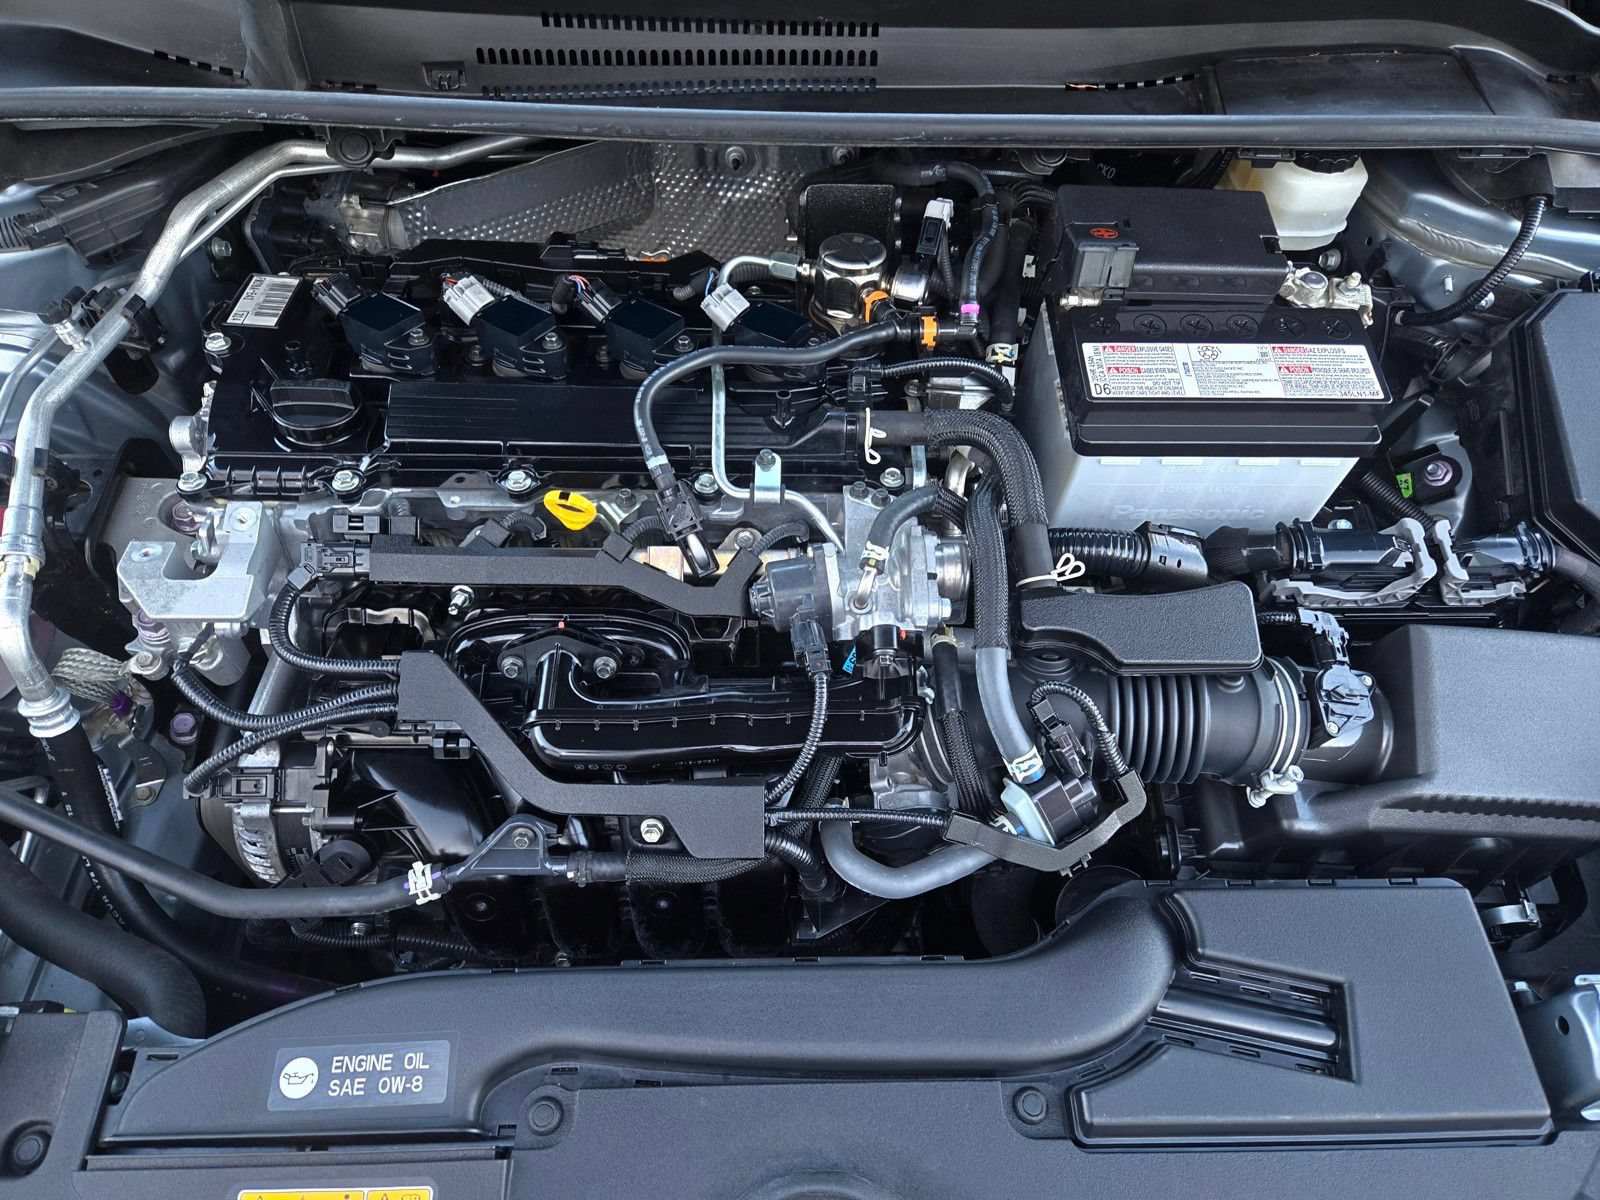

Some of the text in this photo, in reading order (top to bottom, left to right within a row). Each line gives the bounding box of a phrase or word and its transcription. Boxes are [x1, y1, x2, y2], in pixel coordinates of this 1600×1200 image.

[1094, 383, 1111, 395] D6
[1110, 504, 1265, 520] Panasonic
[331, 1052, 430, 1074] ENGINE OIL
[328, 1077, 367, 1097] SAE
